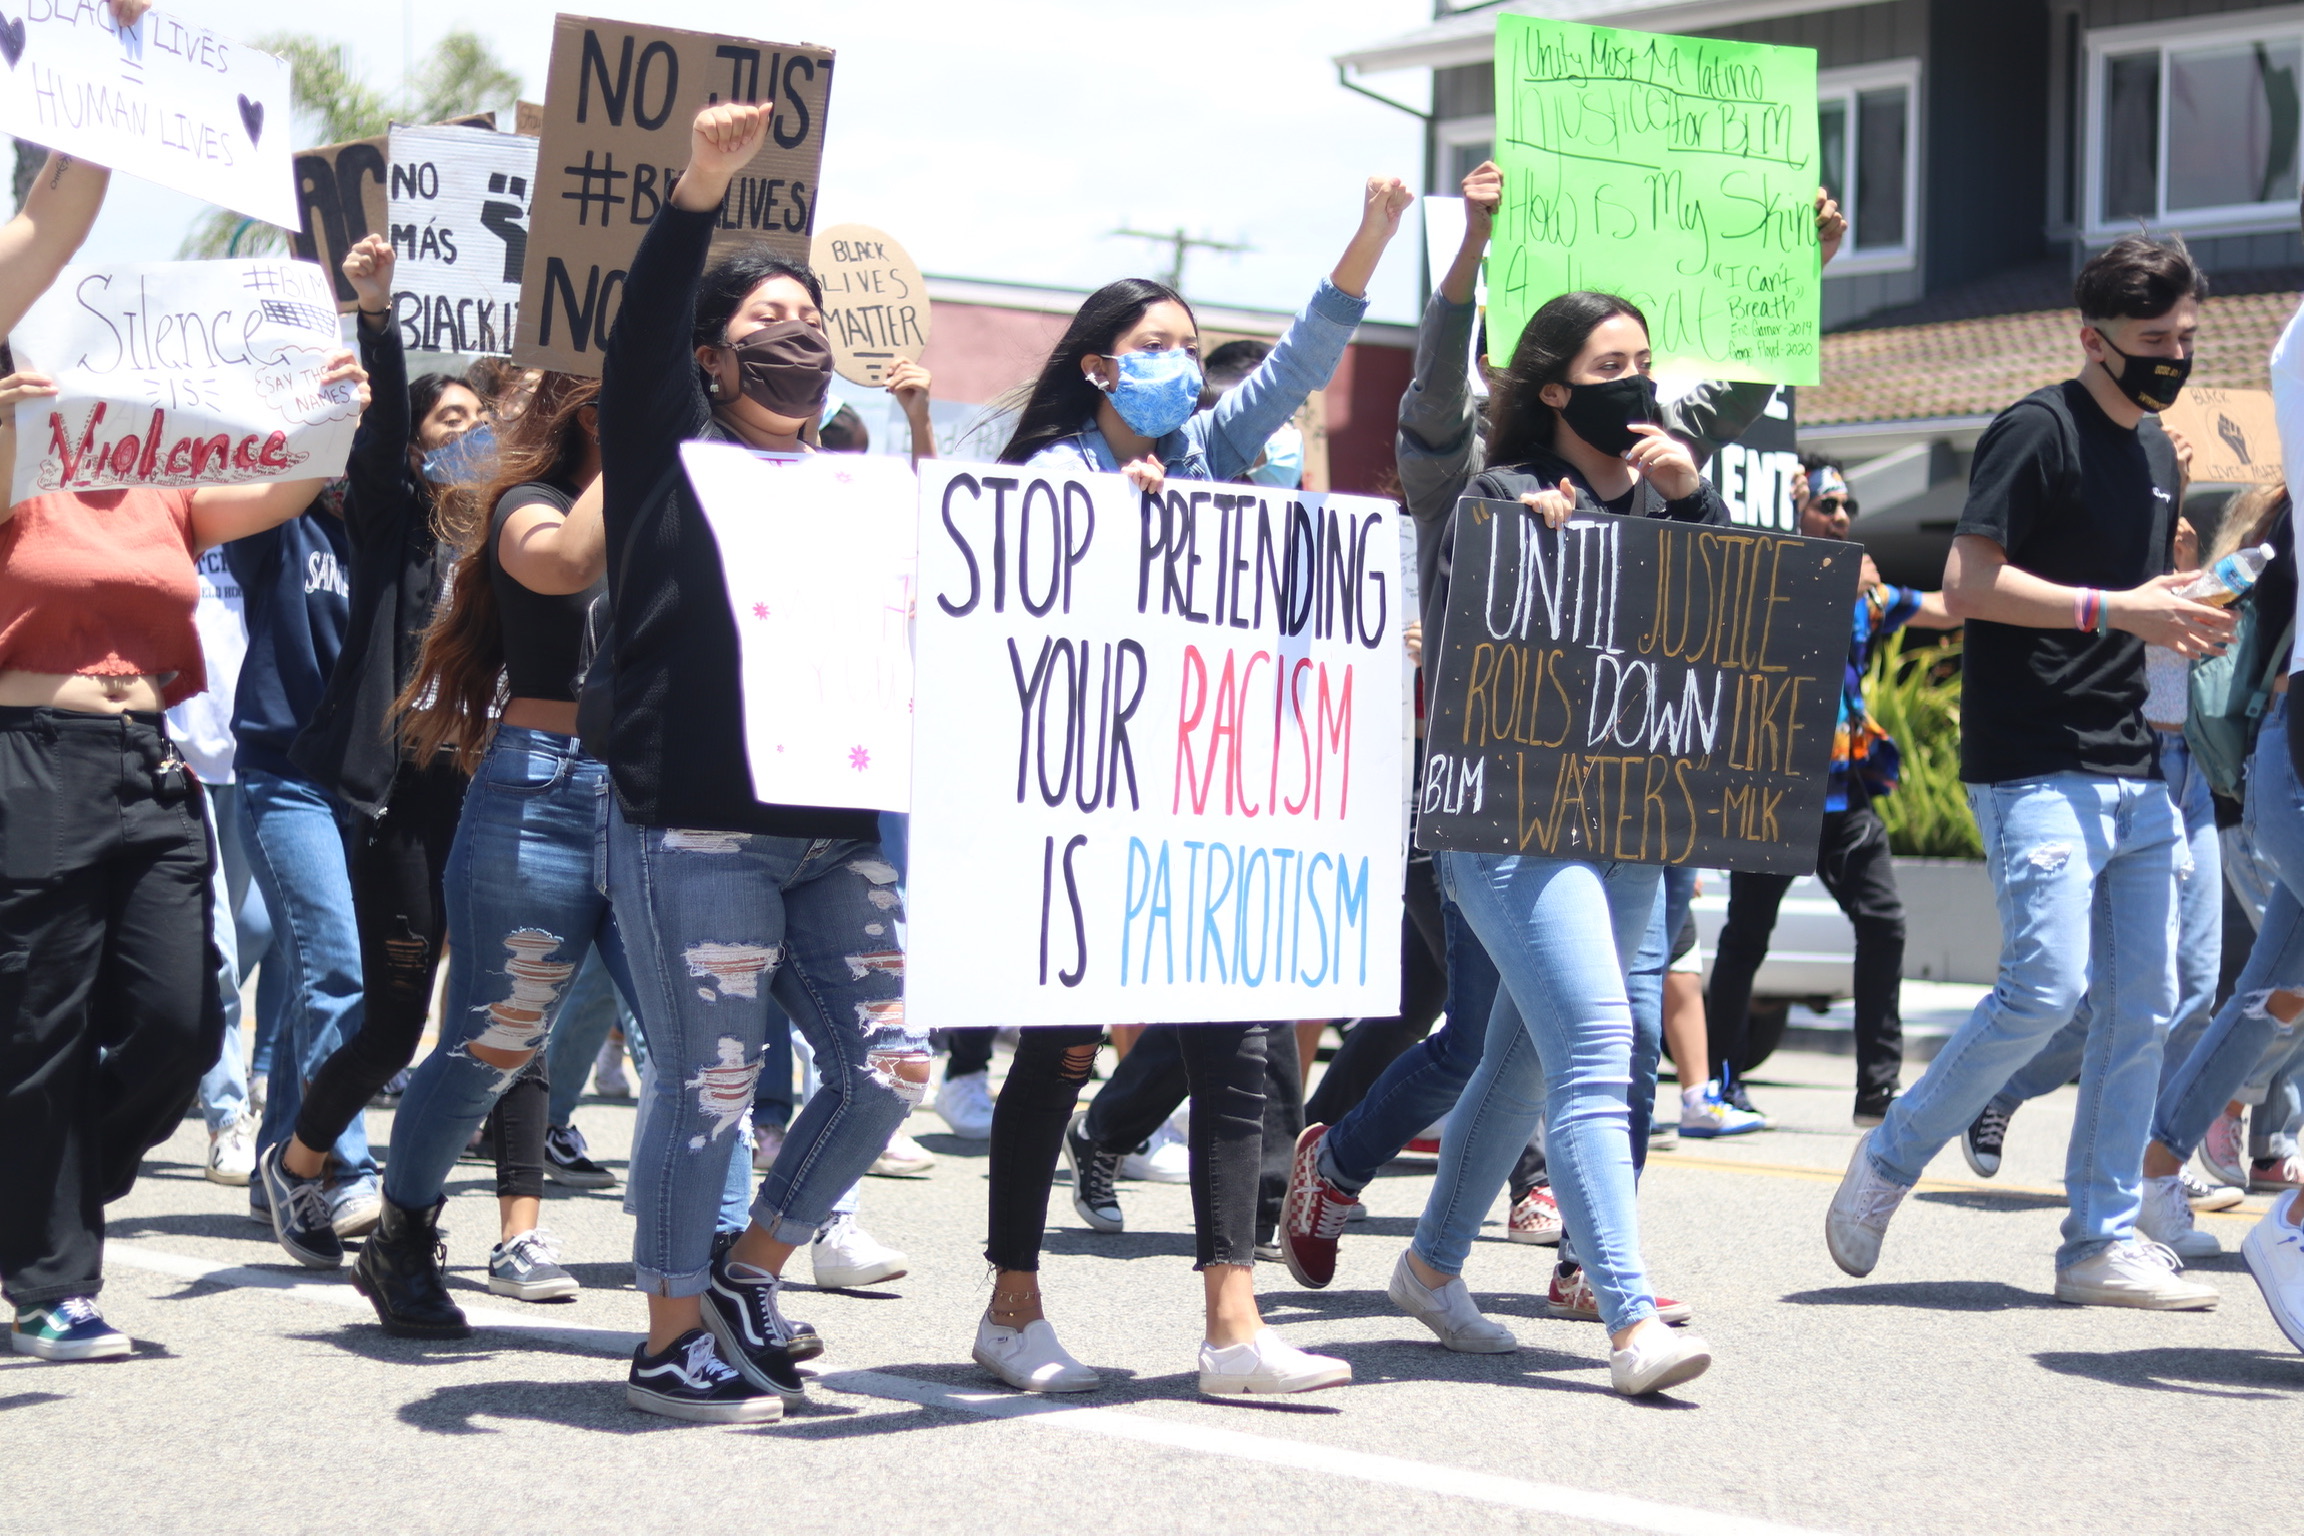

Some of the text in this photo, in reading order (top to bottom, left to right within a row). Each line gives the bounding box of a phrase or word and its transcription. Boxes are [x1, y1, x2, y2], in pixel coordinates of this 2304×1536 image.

[153, 16, 229, 73] LIVES
[576, 29, 679, 131] NO
[32, 62, 234, 166] HUMAN LIVES
[1718, 102, 1809, 171] BLM
[391, 162, 439, 200] NO
[390, 216, 458, 265] MÁS
[832, 239, 890, 263] BLACK
[1645, 169, 1709, 276] My
[1720, 171, 1818, 253] Skin
[243, 264, 331, 307] #BLM
[821, 268, 909, 300] LIVES
[77, 274, 291, 374] Silence
[391, 291, 496, 354] BLACK
[822, 305, 925, 349] MATTER
[264, 372, 294, 395] SAY
[295, 384, 351, 414] NAMES
[49, 401, 288, 489] Violence
[937, 472, 1095, 617] STOP
[1137, 489, 1387, 649] PRETENDING
[1638, 528, 1805, 673] JUSTICE
[1007, 634, 1353, 820] YOUR RACISM
[1462, 643, 1816, 777] ROLLS DOWN LIKE
[1424, 754, 1486, 815] BLM
[1039, 834, 1369, 988] IS PATRIOTISM
